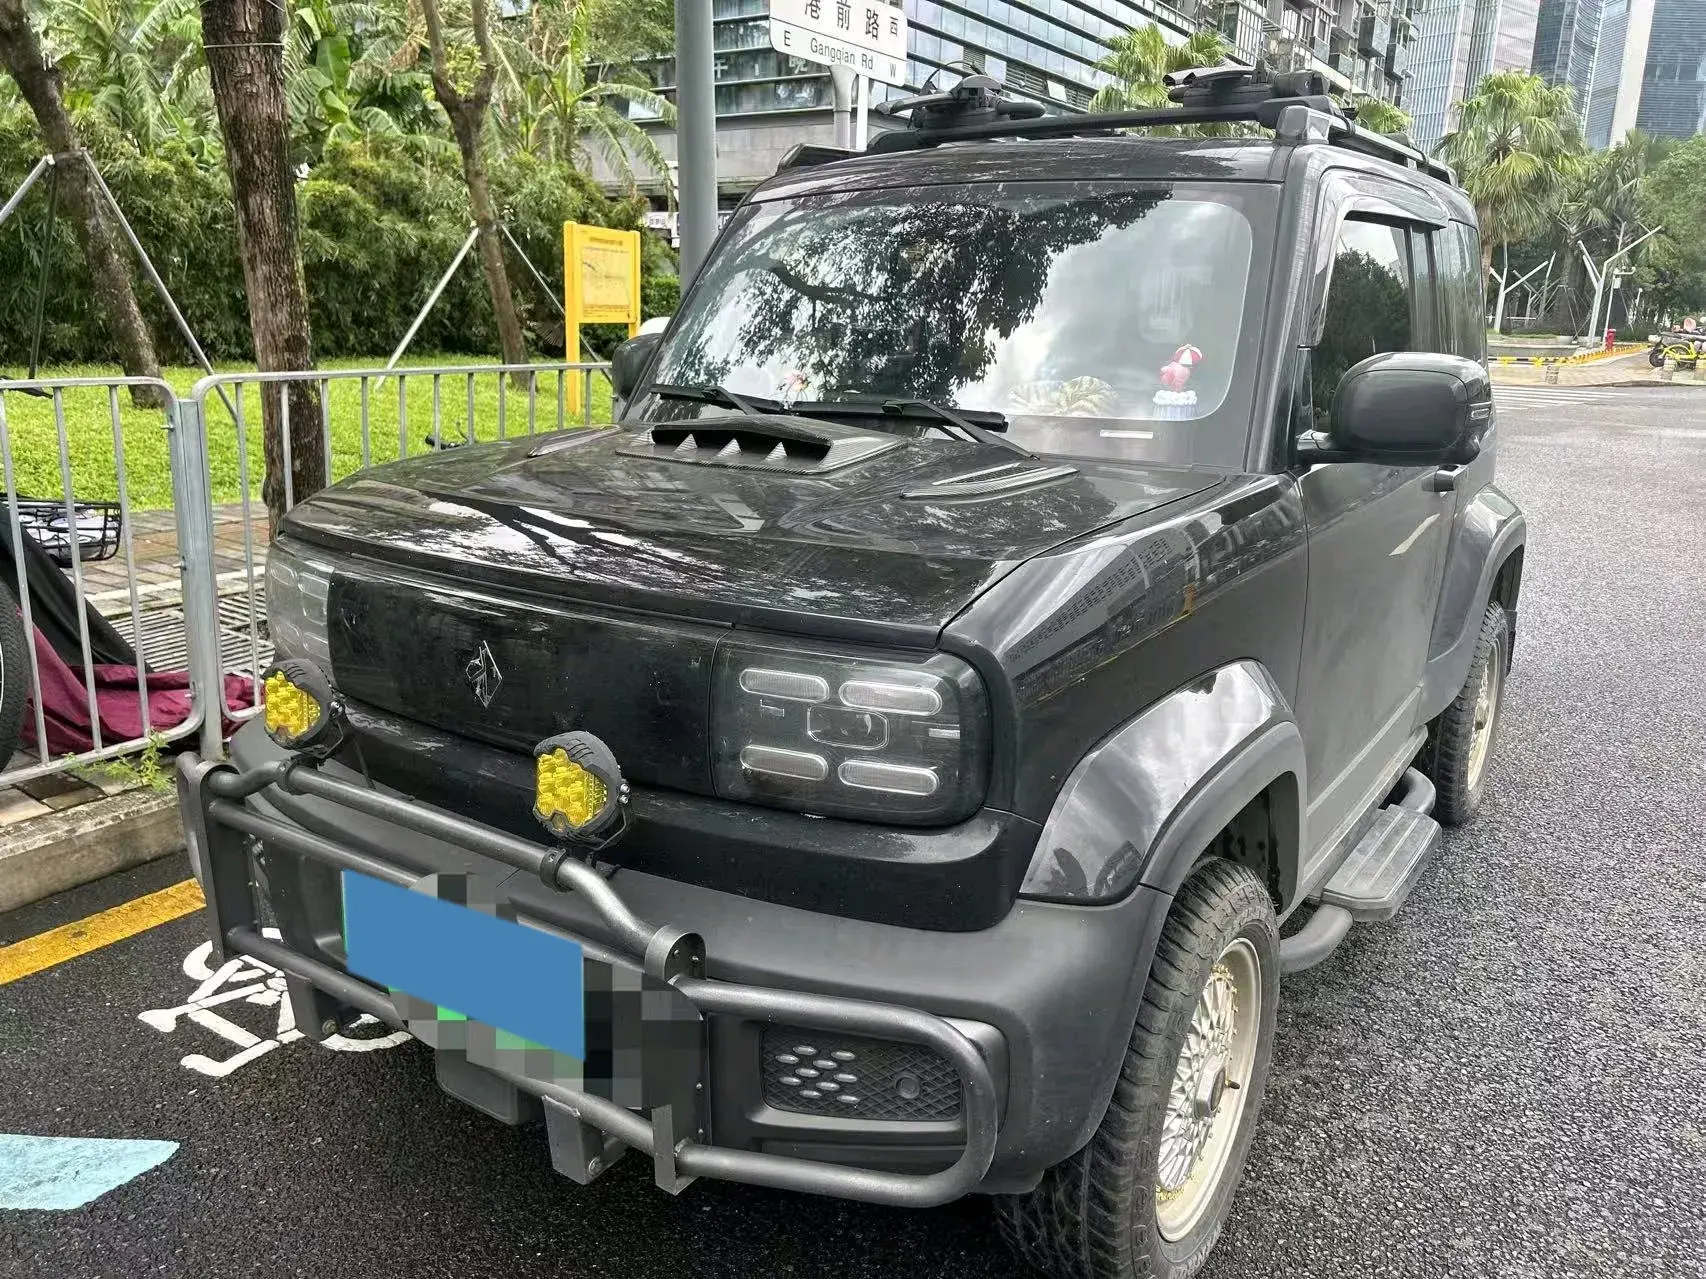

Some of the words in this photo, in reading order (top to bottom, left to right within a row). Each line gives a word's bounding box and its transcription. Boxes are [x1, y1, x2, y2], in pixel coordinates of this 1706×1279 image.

[784, 30, 792, 47] E
[810, 38, 856, 64] Gangqian
[861, 53, 874, 70] Rd
[889, 64, 897, 78] W
